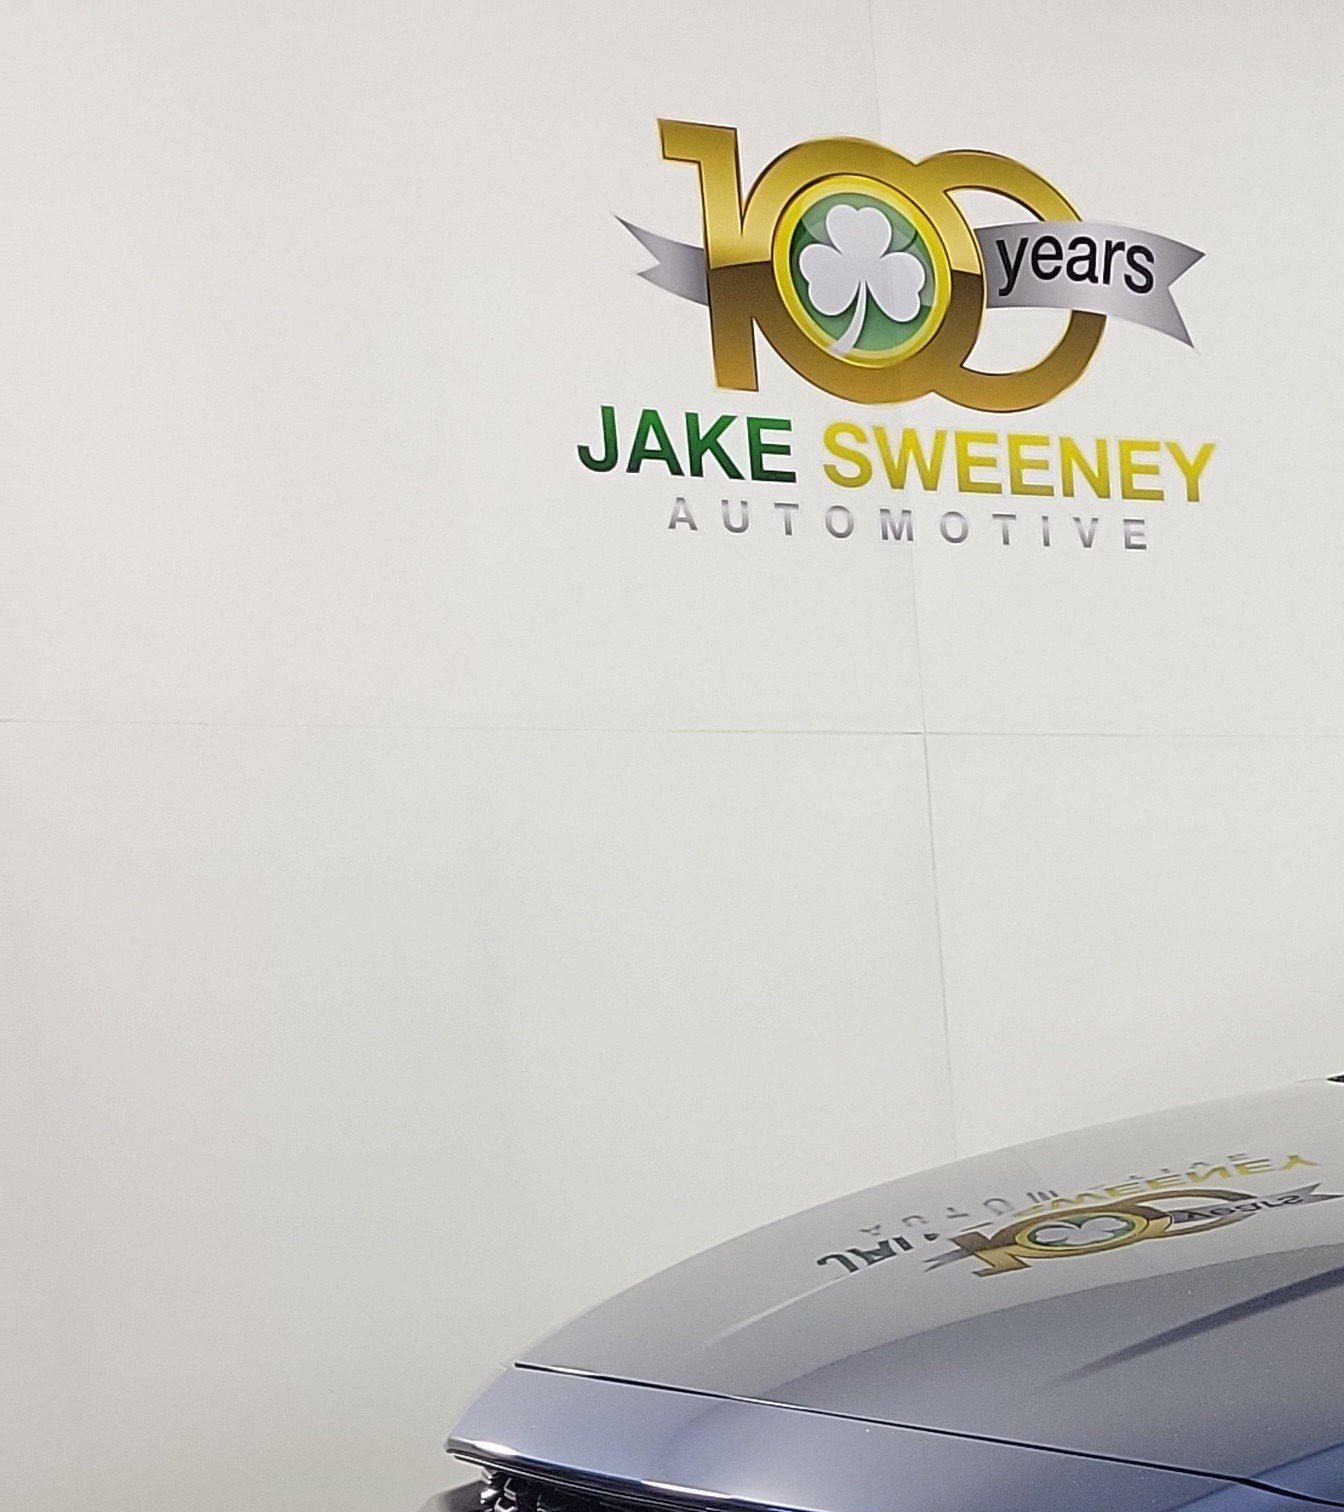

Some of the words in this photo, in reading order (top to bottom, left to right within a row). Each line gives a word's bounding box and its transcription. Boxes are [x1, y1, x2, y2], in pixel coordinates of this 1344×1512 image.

[656, 117, 1108, 413] 100
[994, 234, 1155, 297] years
[577, 404, 798, 484] JAKE
[822, 420, 1216, 503] SWEENEY
[667, 496, 1149, 551] AUTOMOTIVE
